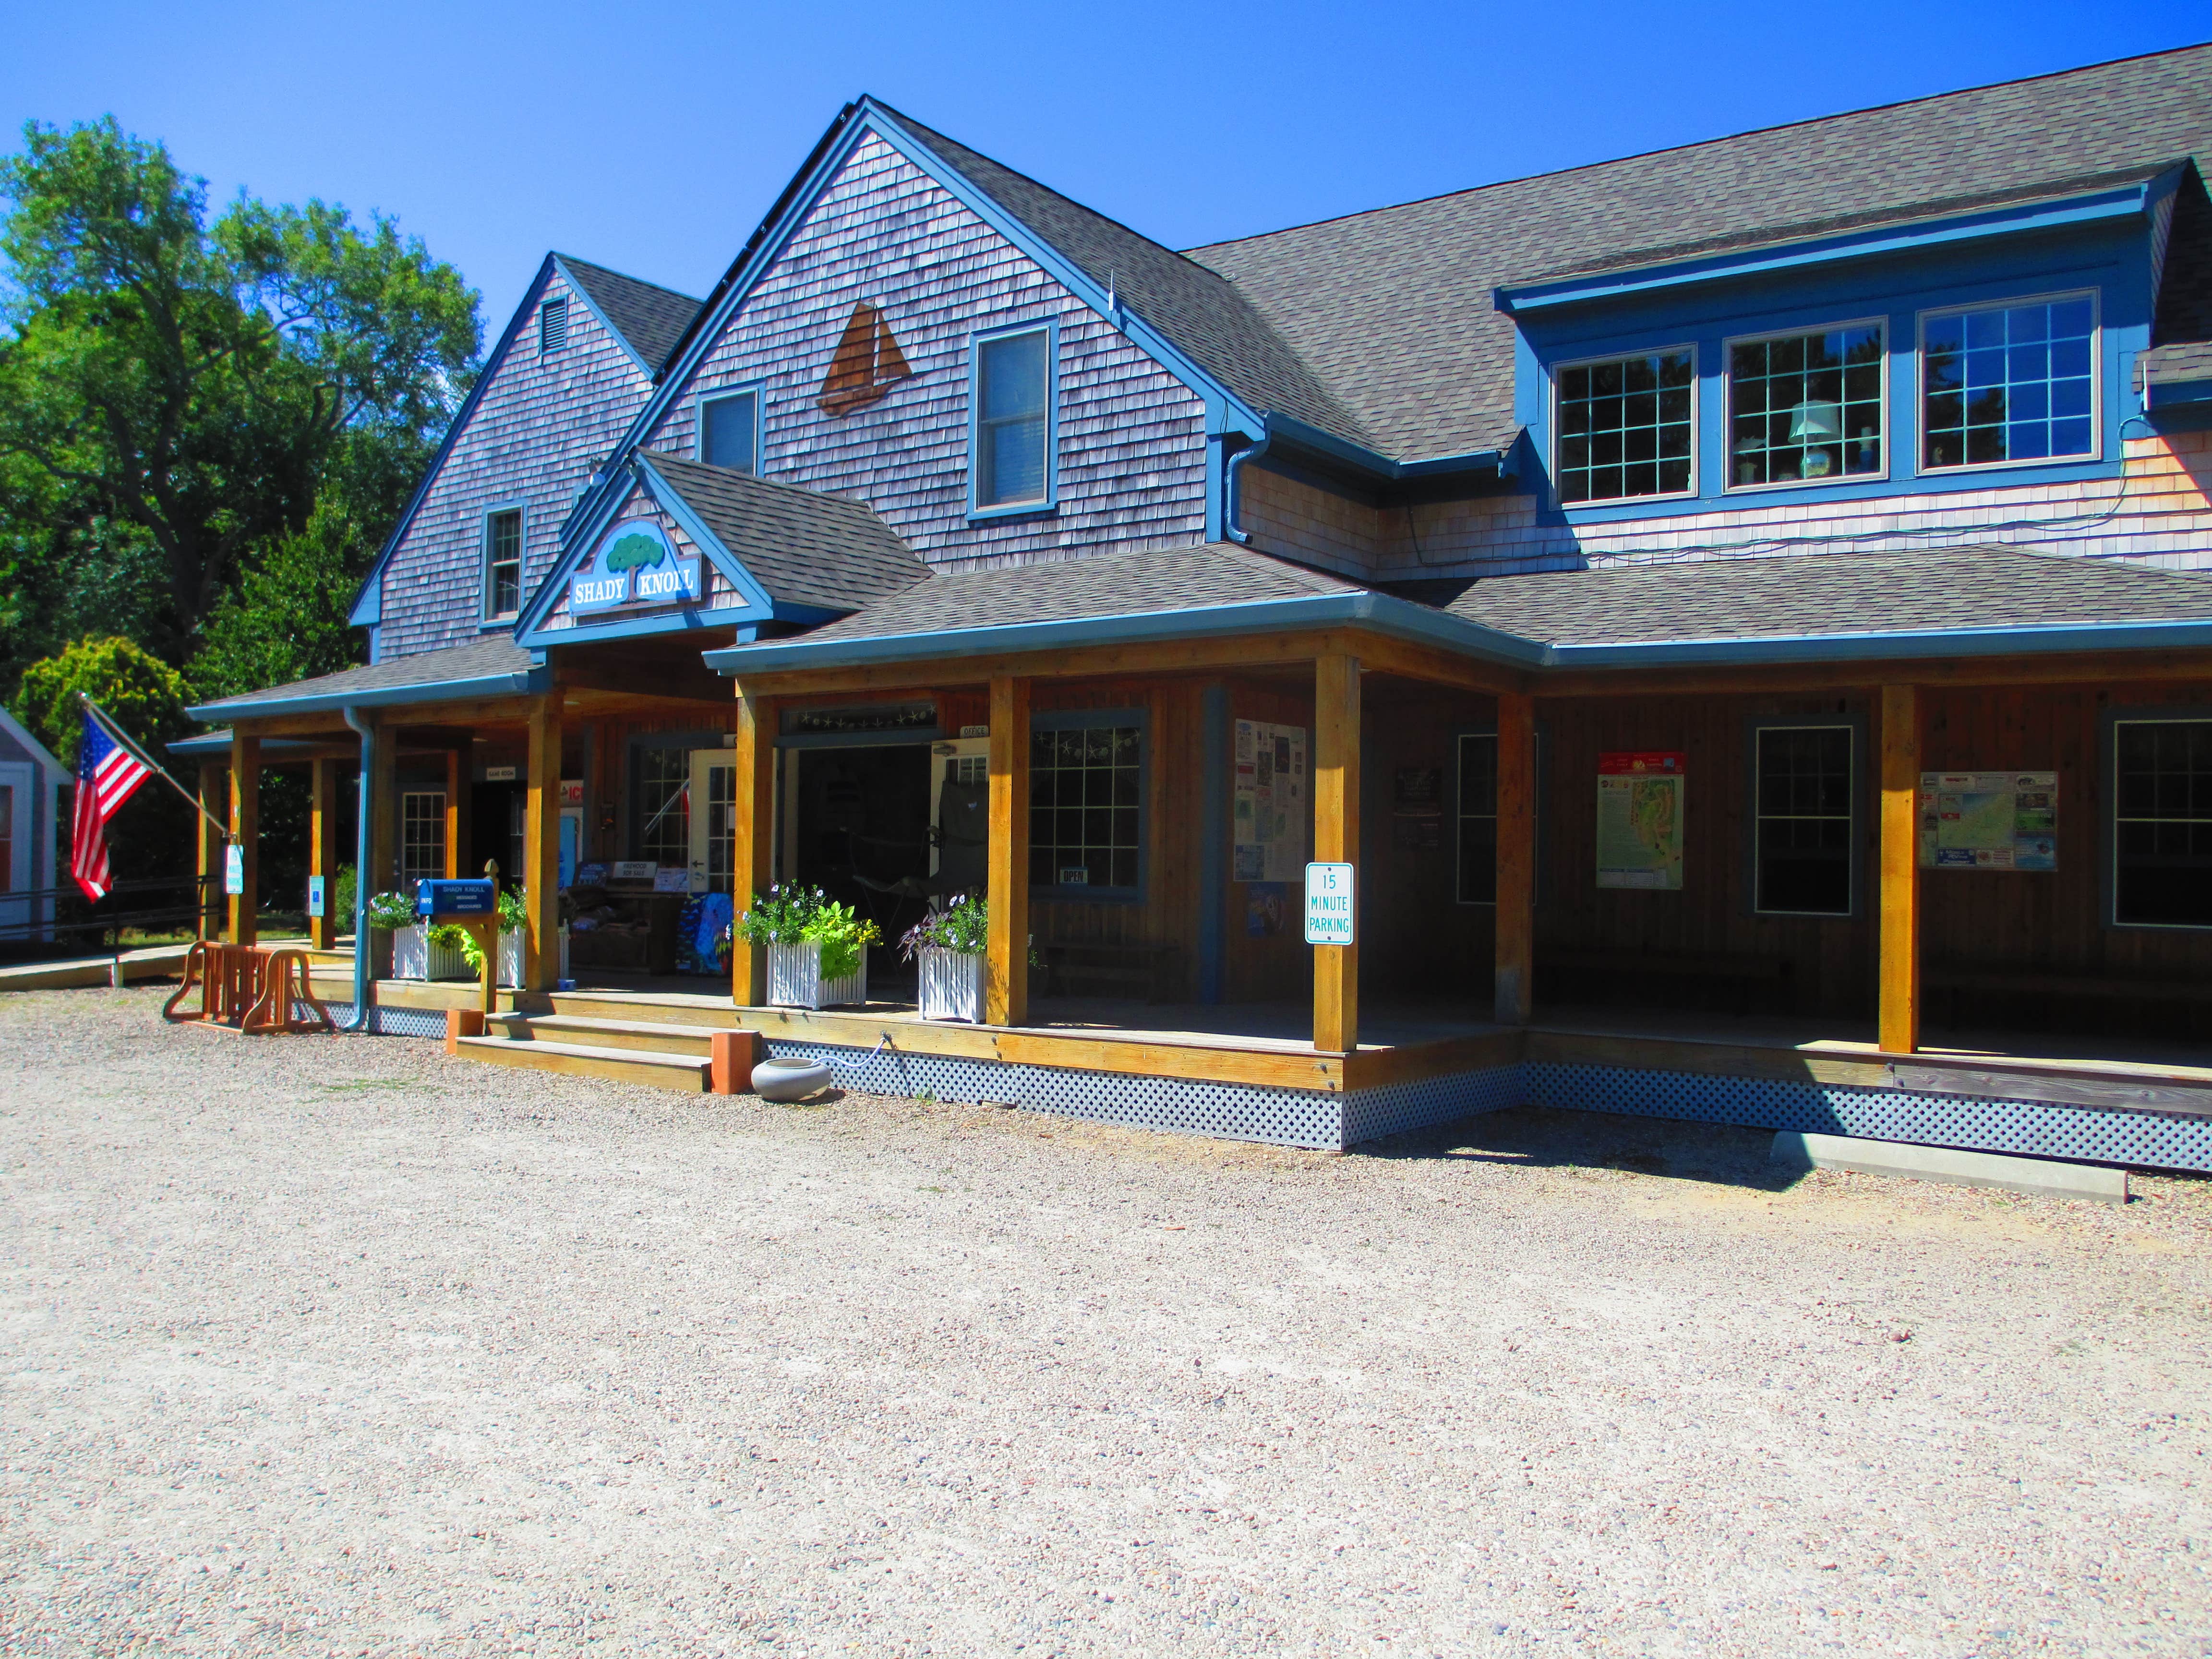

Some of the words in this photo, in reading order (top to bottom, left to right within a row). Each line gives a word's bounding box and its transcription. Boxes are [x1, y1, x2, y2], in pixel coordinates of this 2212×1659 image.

[575, 578, 625, 604] SHADY
[640, 569, 694, 596] KNOLL
[1063, 870, 1084, 882] OPEN
[1323, 874, 1336, 890] 15
[1311, 896, 1347, 911] MINUTE
[1310, 917, 1349, 933] PARKING
